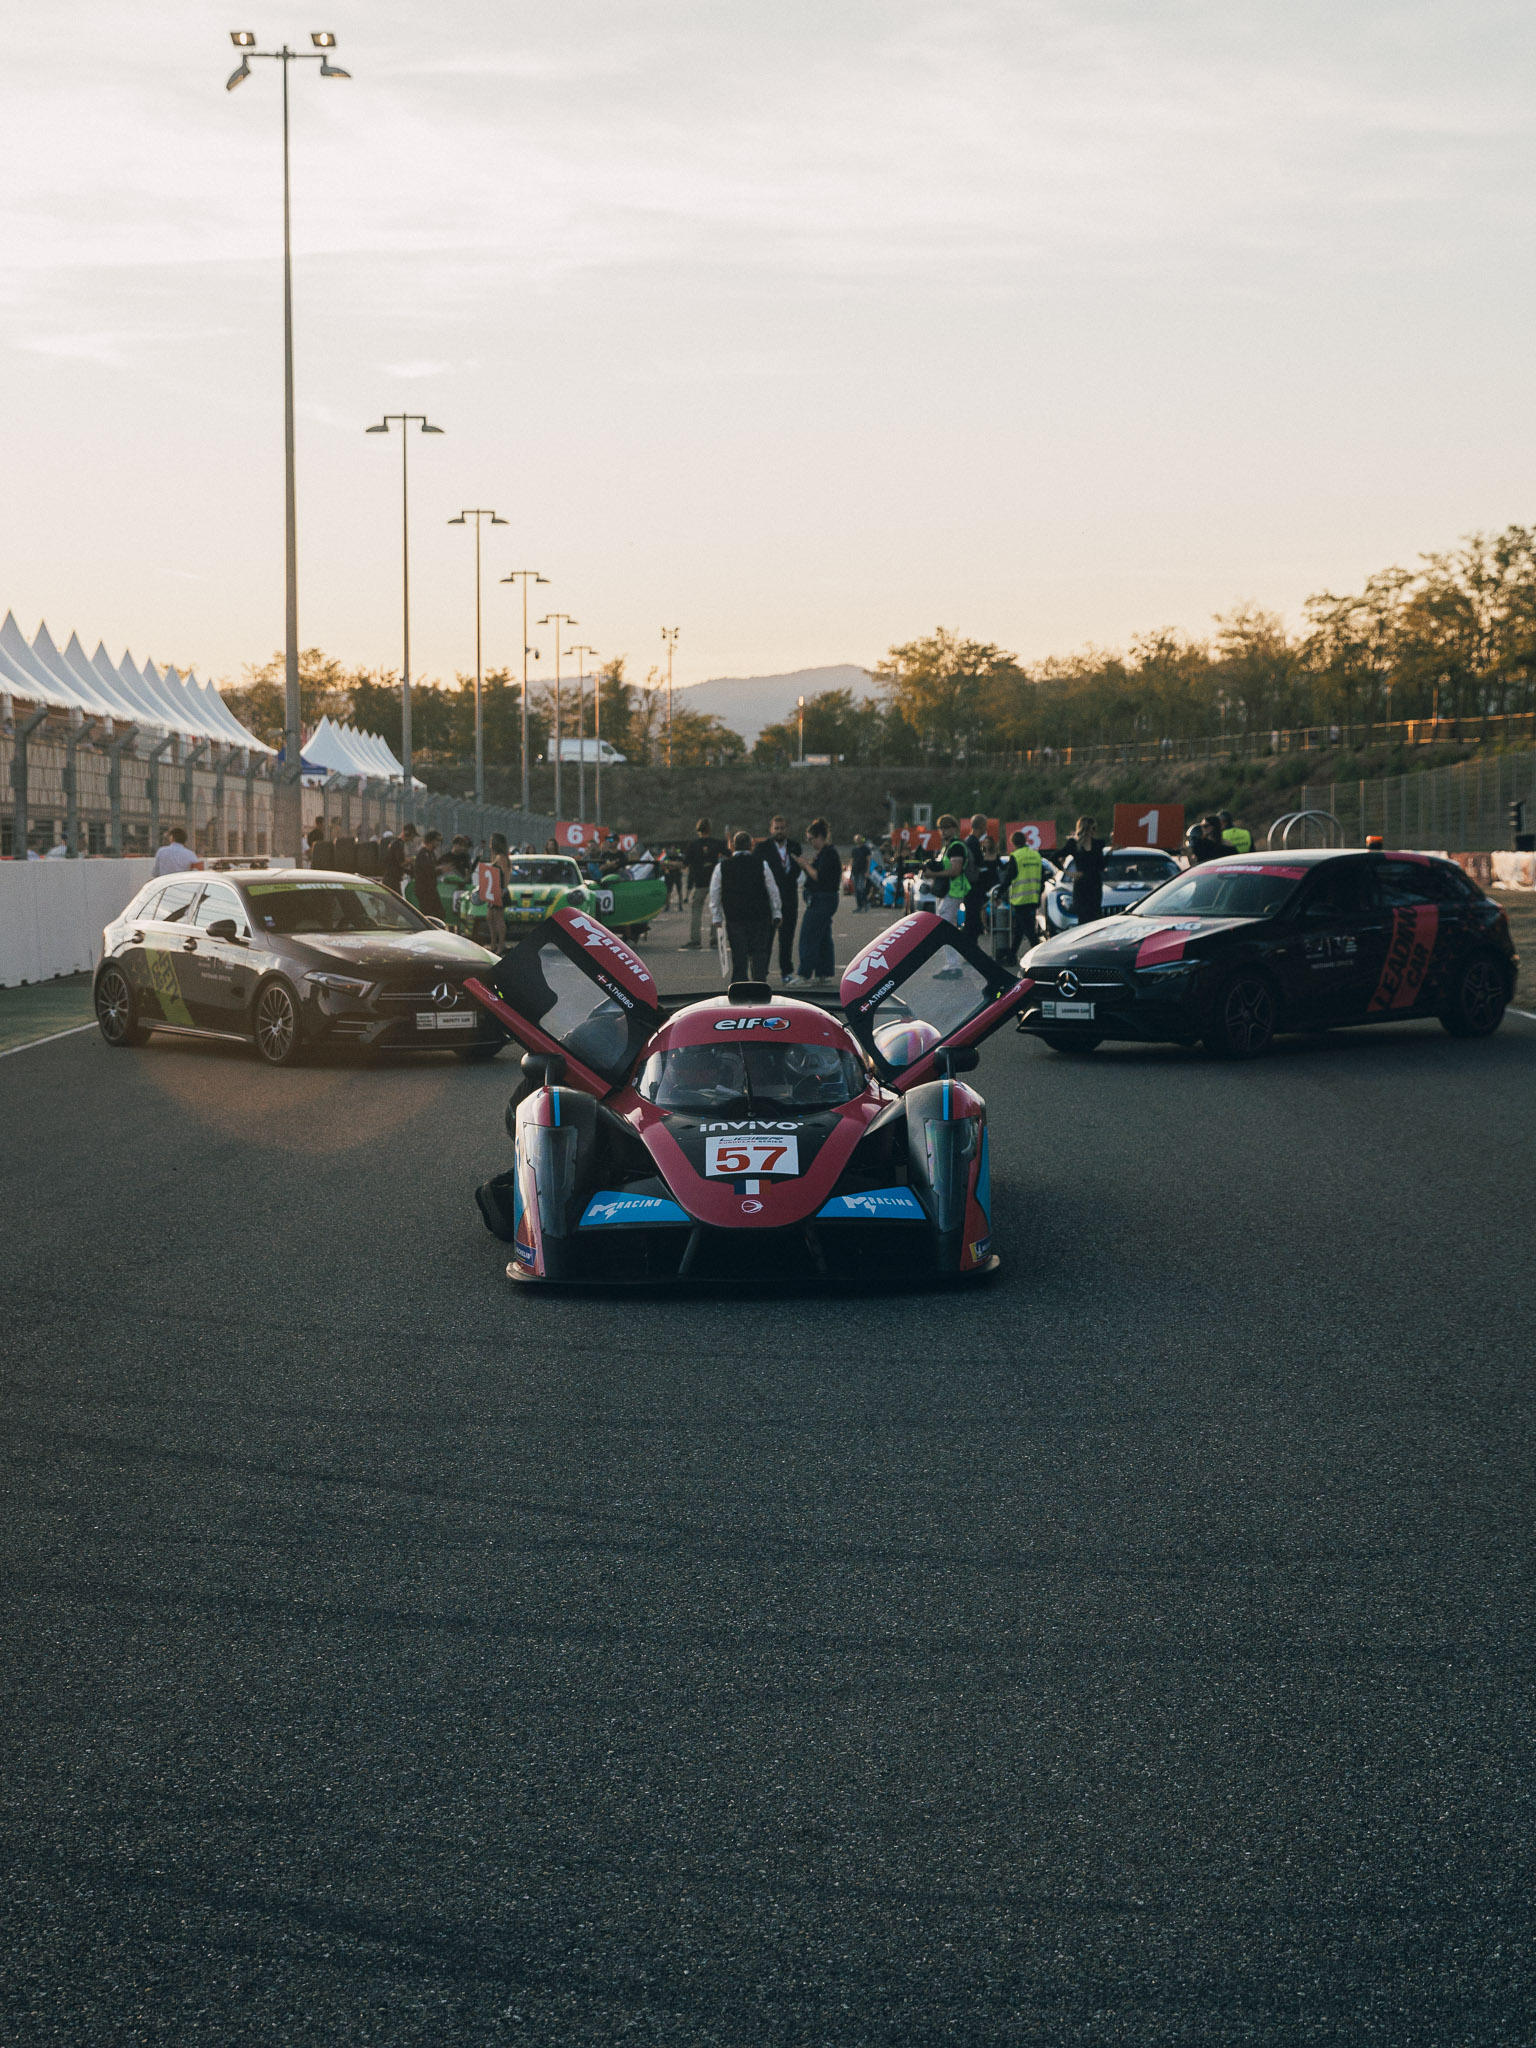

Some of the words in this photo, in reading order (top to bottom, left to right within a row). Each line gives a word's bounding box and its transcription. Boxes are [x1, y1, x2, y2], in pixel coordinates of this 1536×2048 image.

[567, 825, 583, 844] 6
[1020, 825, 1042, 850] 3
[1138, 810, 1159, 844] 1
[918, 833, 932, 849] 7
[485, 870, 494, 901] 2
[869, 920, 918, 958] RACING
[602, 937, 650, 982] RACING
[606, 983, 634, 1009] A.THERBO
[868, 980, 895, 1005] A.THERBO
[715, 1018, 762, 1030] elf
[716, 1147, 788, 1172] 57
[616, 1200, 662, 1209] RACING
[867, 1196, 913, 1206] RACING
